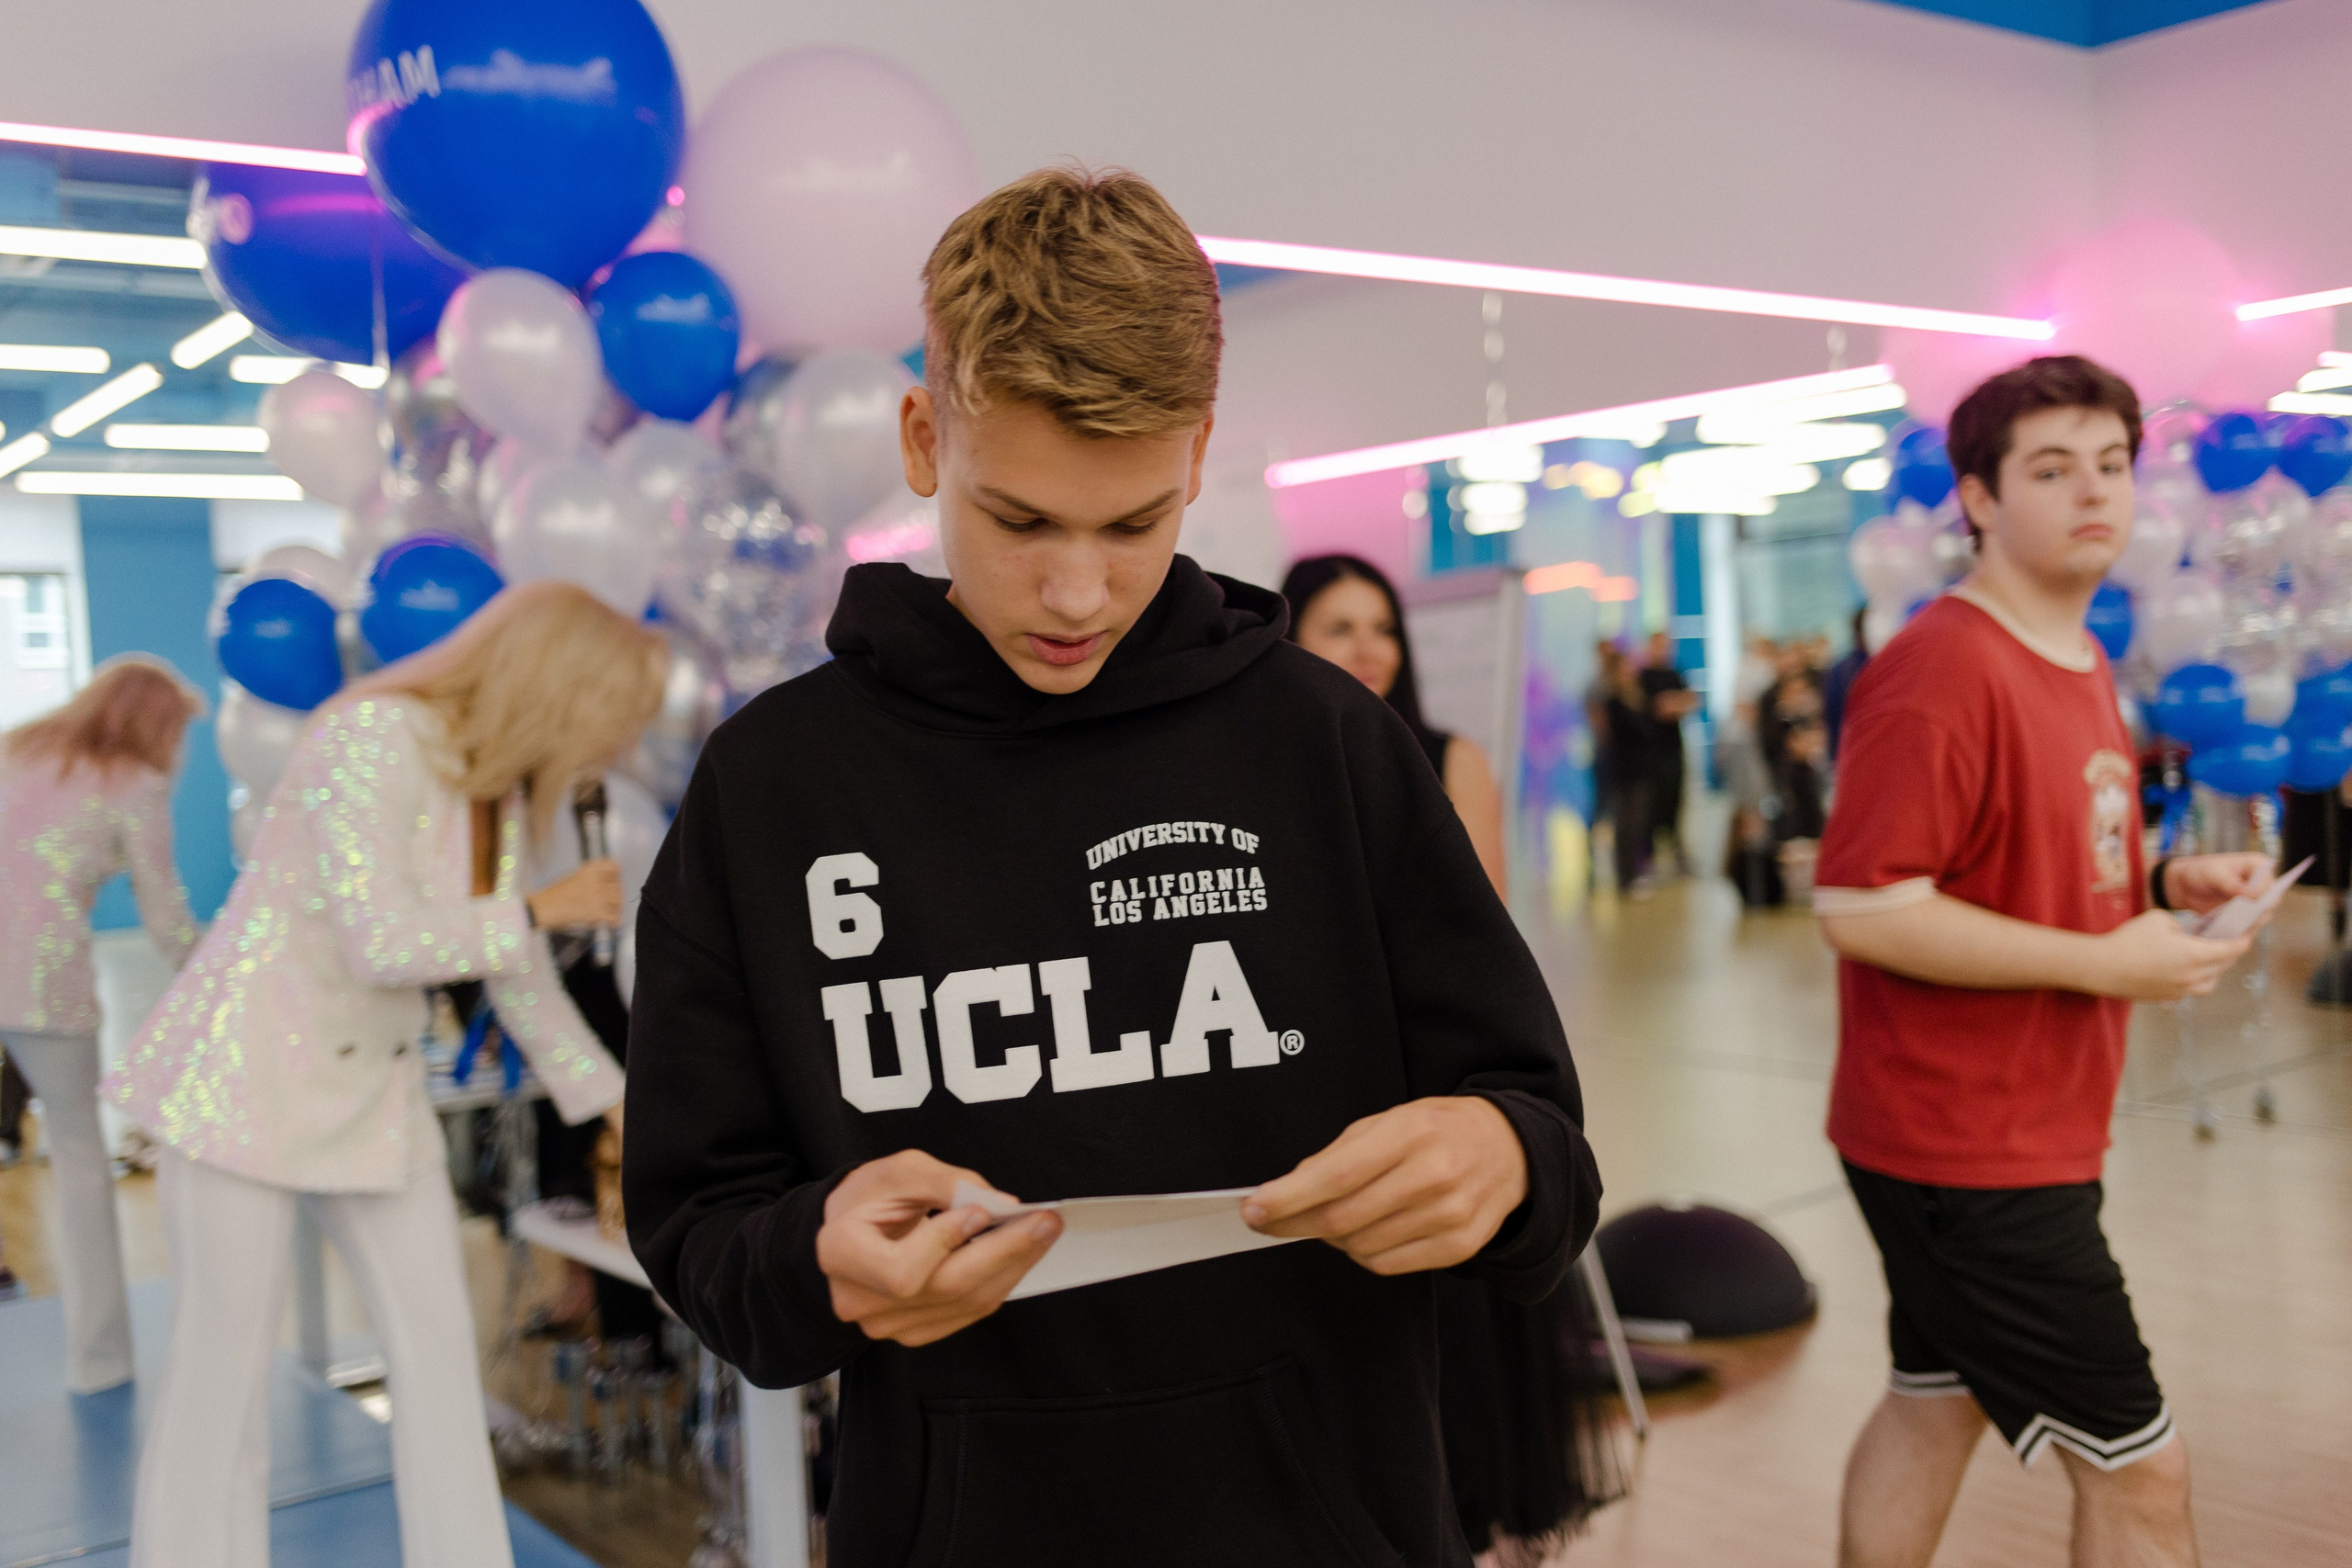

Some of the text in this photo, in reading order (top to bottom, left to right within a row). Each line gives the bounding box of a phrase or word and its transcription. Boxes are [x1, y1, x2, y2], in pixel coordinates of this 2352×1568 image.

[1085, 821, 1260, 871] UNIVERSITY OF
[805, 852, 884, 960] 6
[1090, 866, 1265, 904] CALIFORNIA
[1091, 888, 1268, 927] LOS ANGELES
